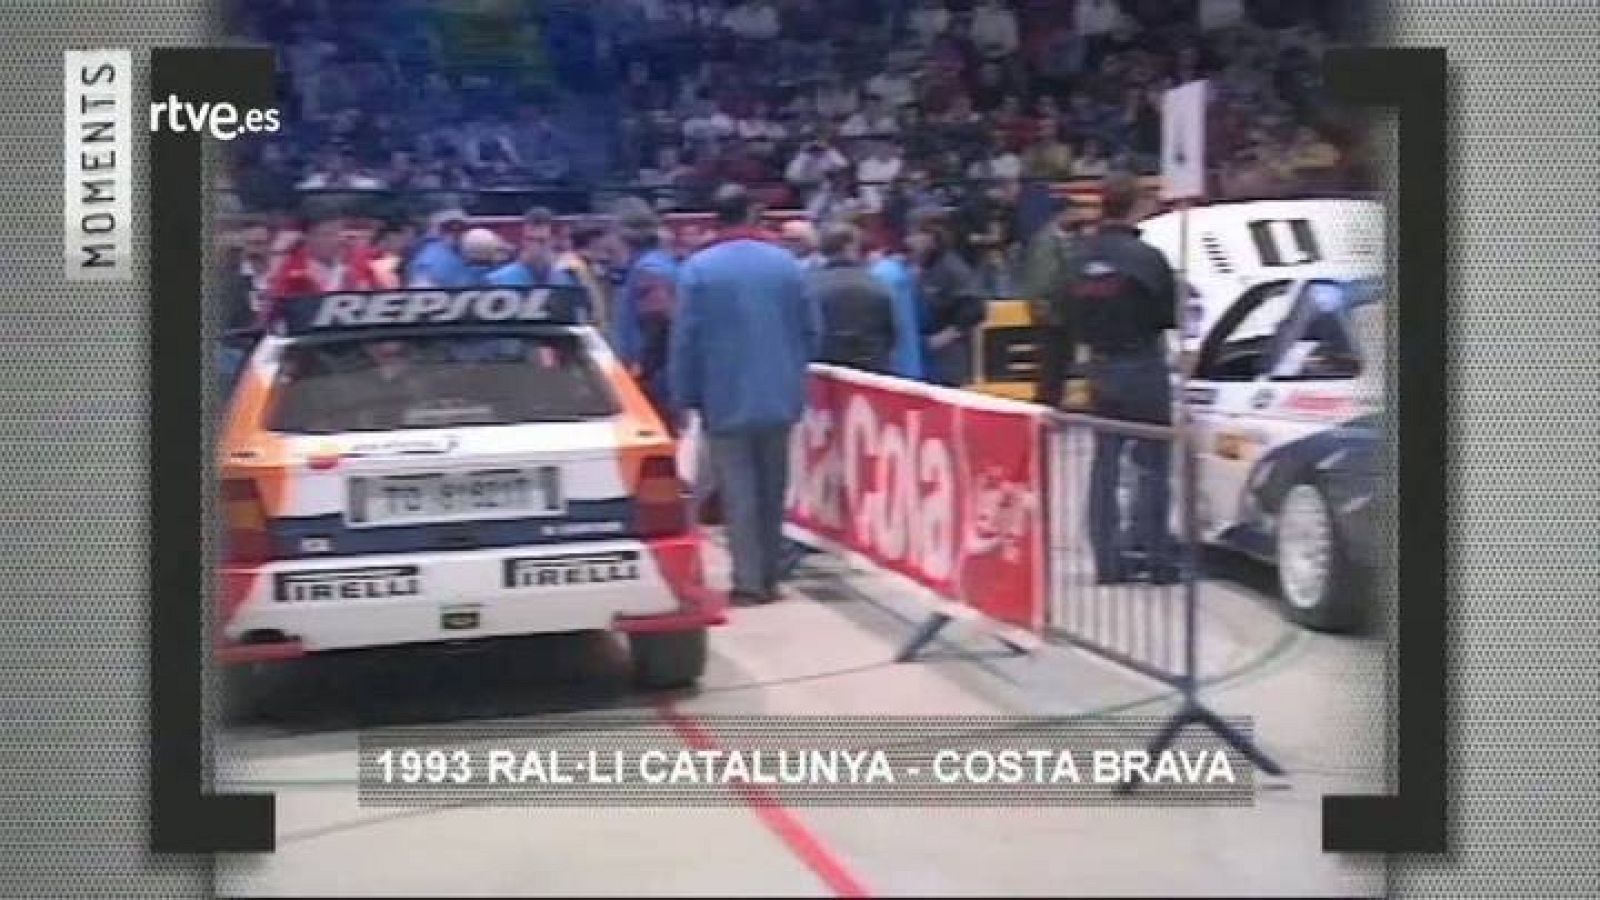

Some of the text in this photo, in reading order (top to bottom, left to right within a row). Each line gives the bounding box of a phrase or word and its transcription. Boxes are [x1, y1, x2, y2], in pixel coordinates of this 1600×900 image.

[314, 288, 552, 326] REPSOL
[274, 565, 421, 603] PIRELLI
[503, 550, 641, 588] PIRELLI
